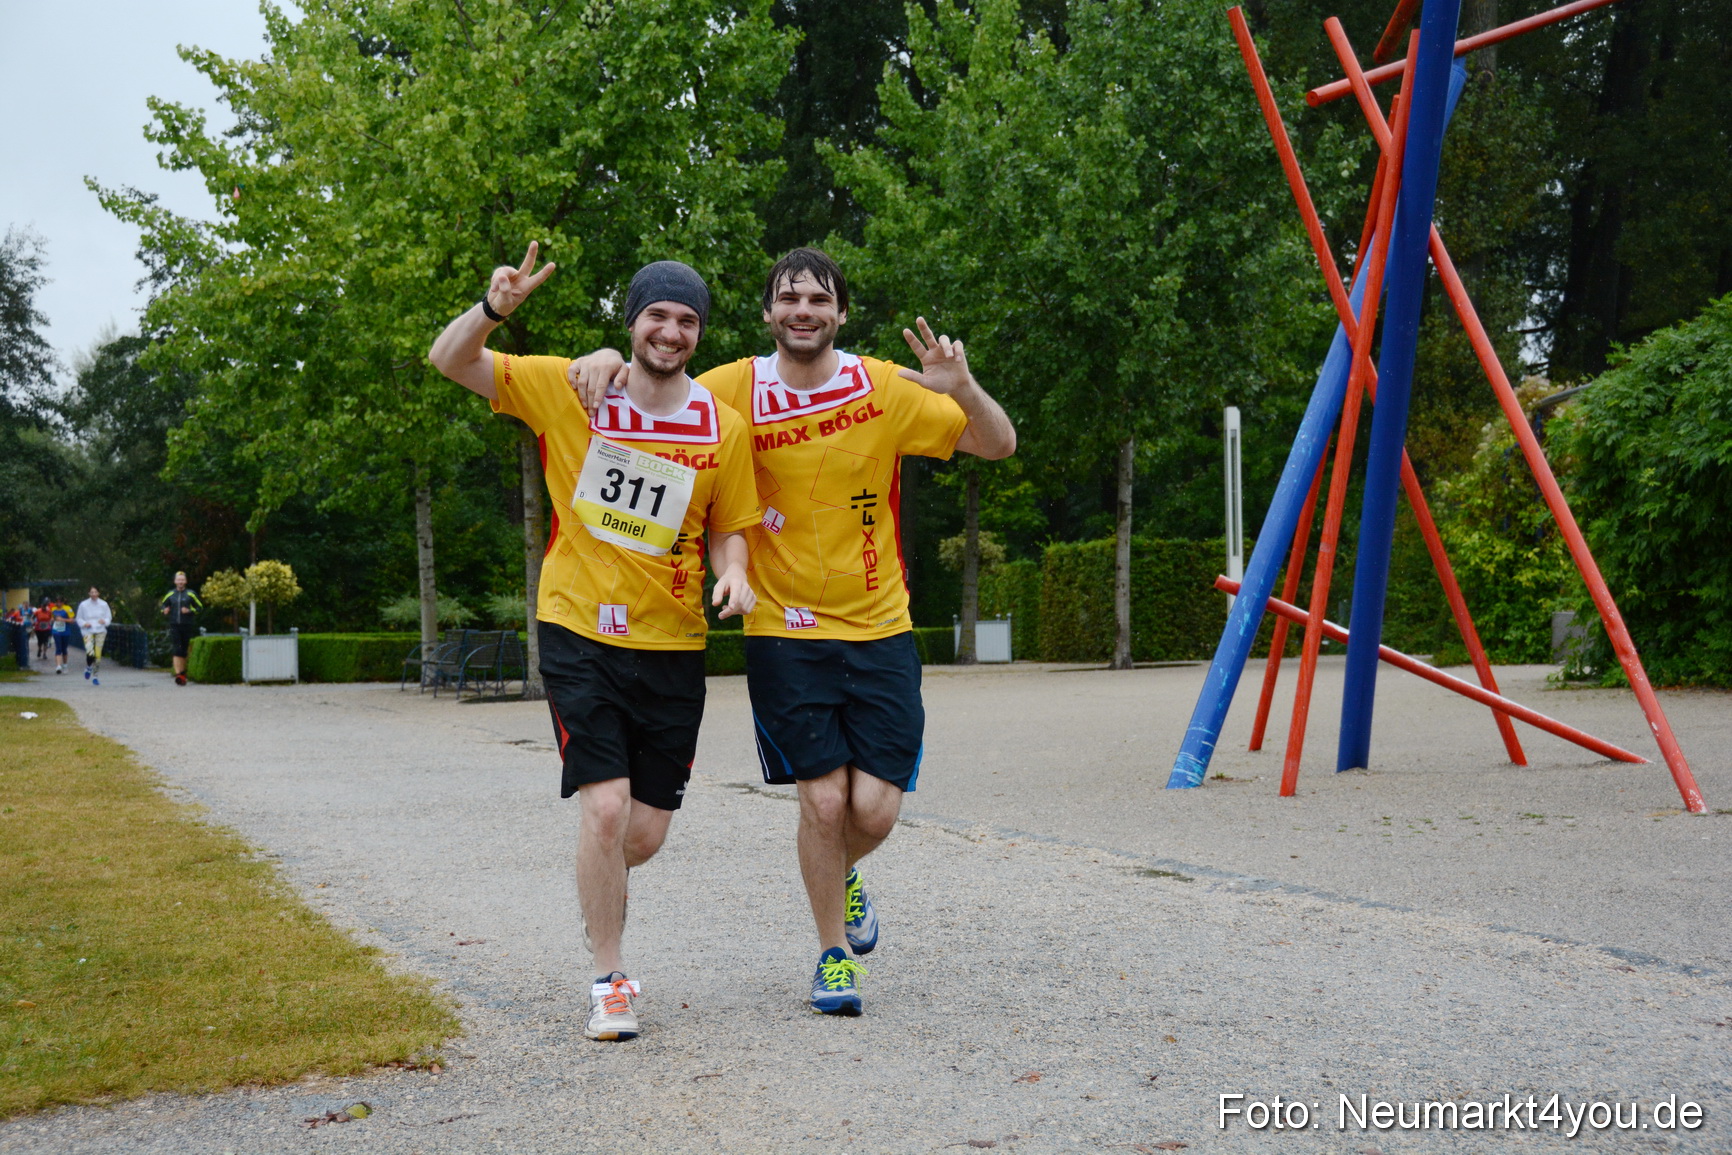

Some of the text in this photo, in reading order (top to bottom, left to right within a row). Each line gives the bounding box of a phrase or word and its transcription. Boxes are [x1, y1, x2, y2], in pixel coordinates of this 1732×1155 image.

[753, 401, 884, 452] MAX BÖGL
[597, 449, 631, 465] NeuerMarkt
[636, 455, 687, 481] BOCK
[600, 468, 667, 518] 311
[601, 512, 646, 538] Daniel
